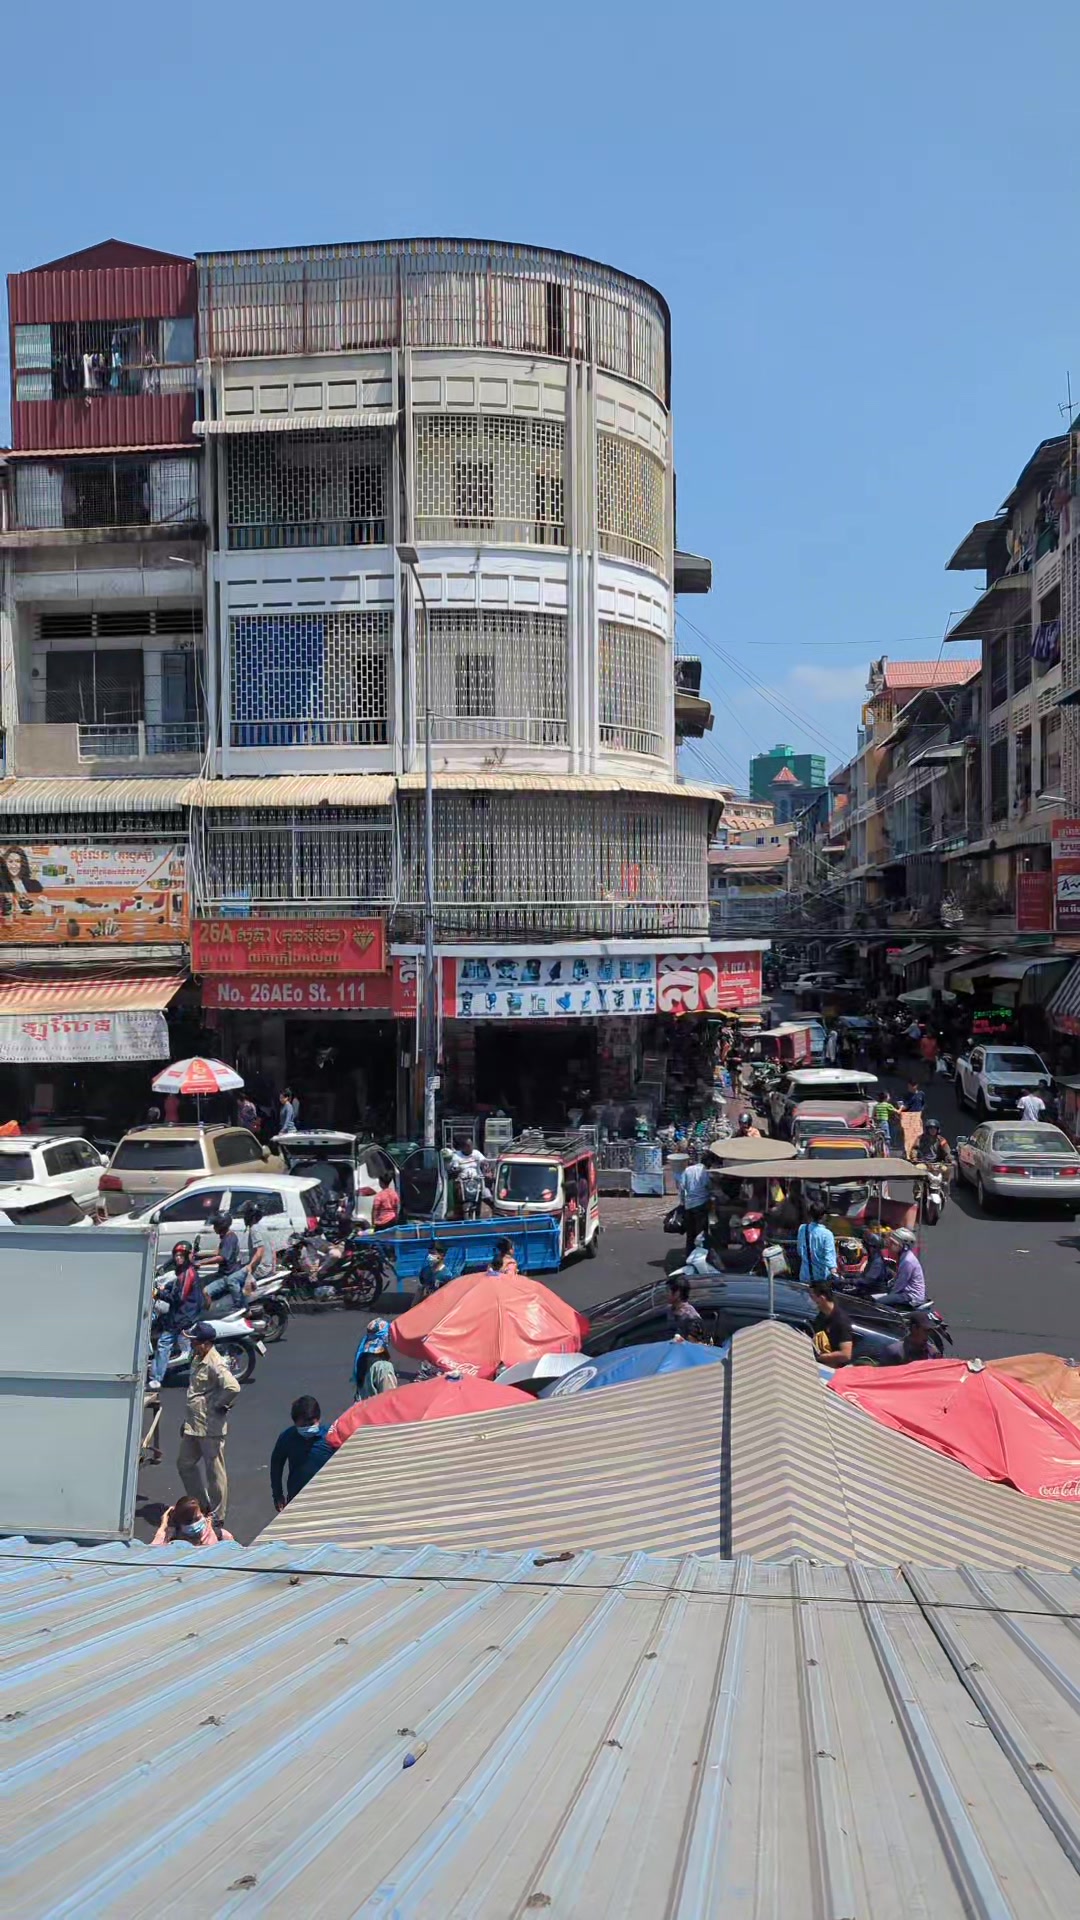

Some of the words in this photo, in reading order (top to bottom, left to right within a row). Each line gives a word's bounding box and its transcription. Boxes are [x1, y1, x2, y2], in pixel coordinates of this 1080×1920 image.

[200, 923, 233, 943] 26A
[218, 983, 244, 1002] No.
[251, 983, 303, 1002] 26AEo
[309, 983, 331, 1002] St.
[337, 982, 366, 1002] 111
